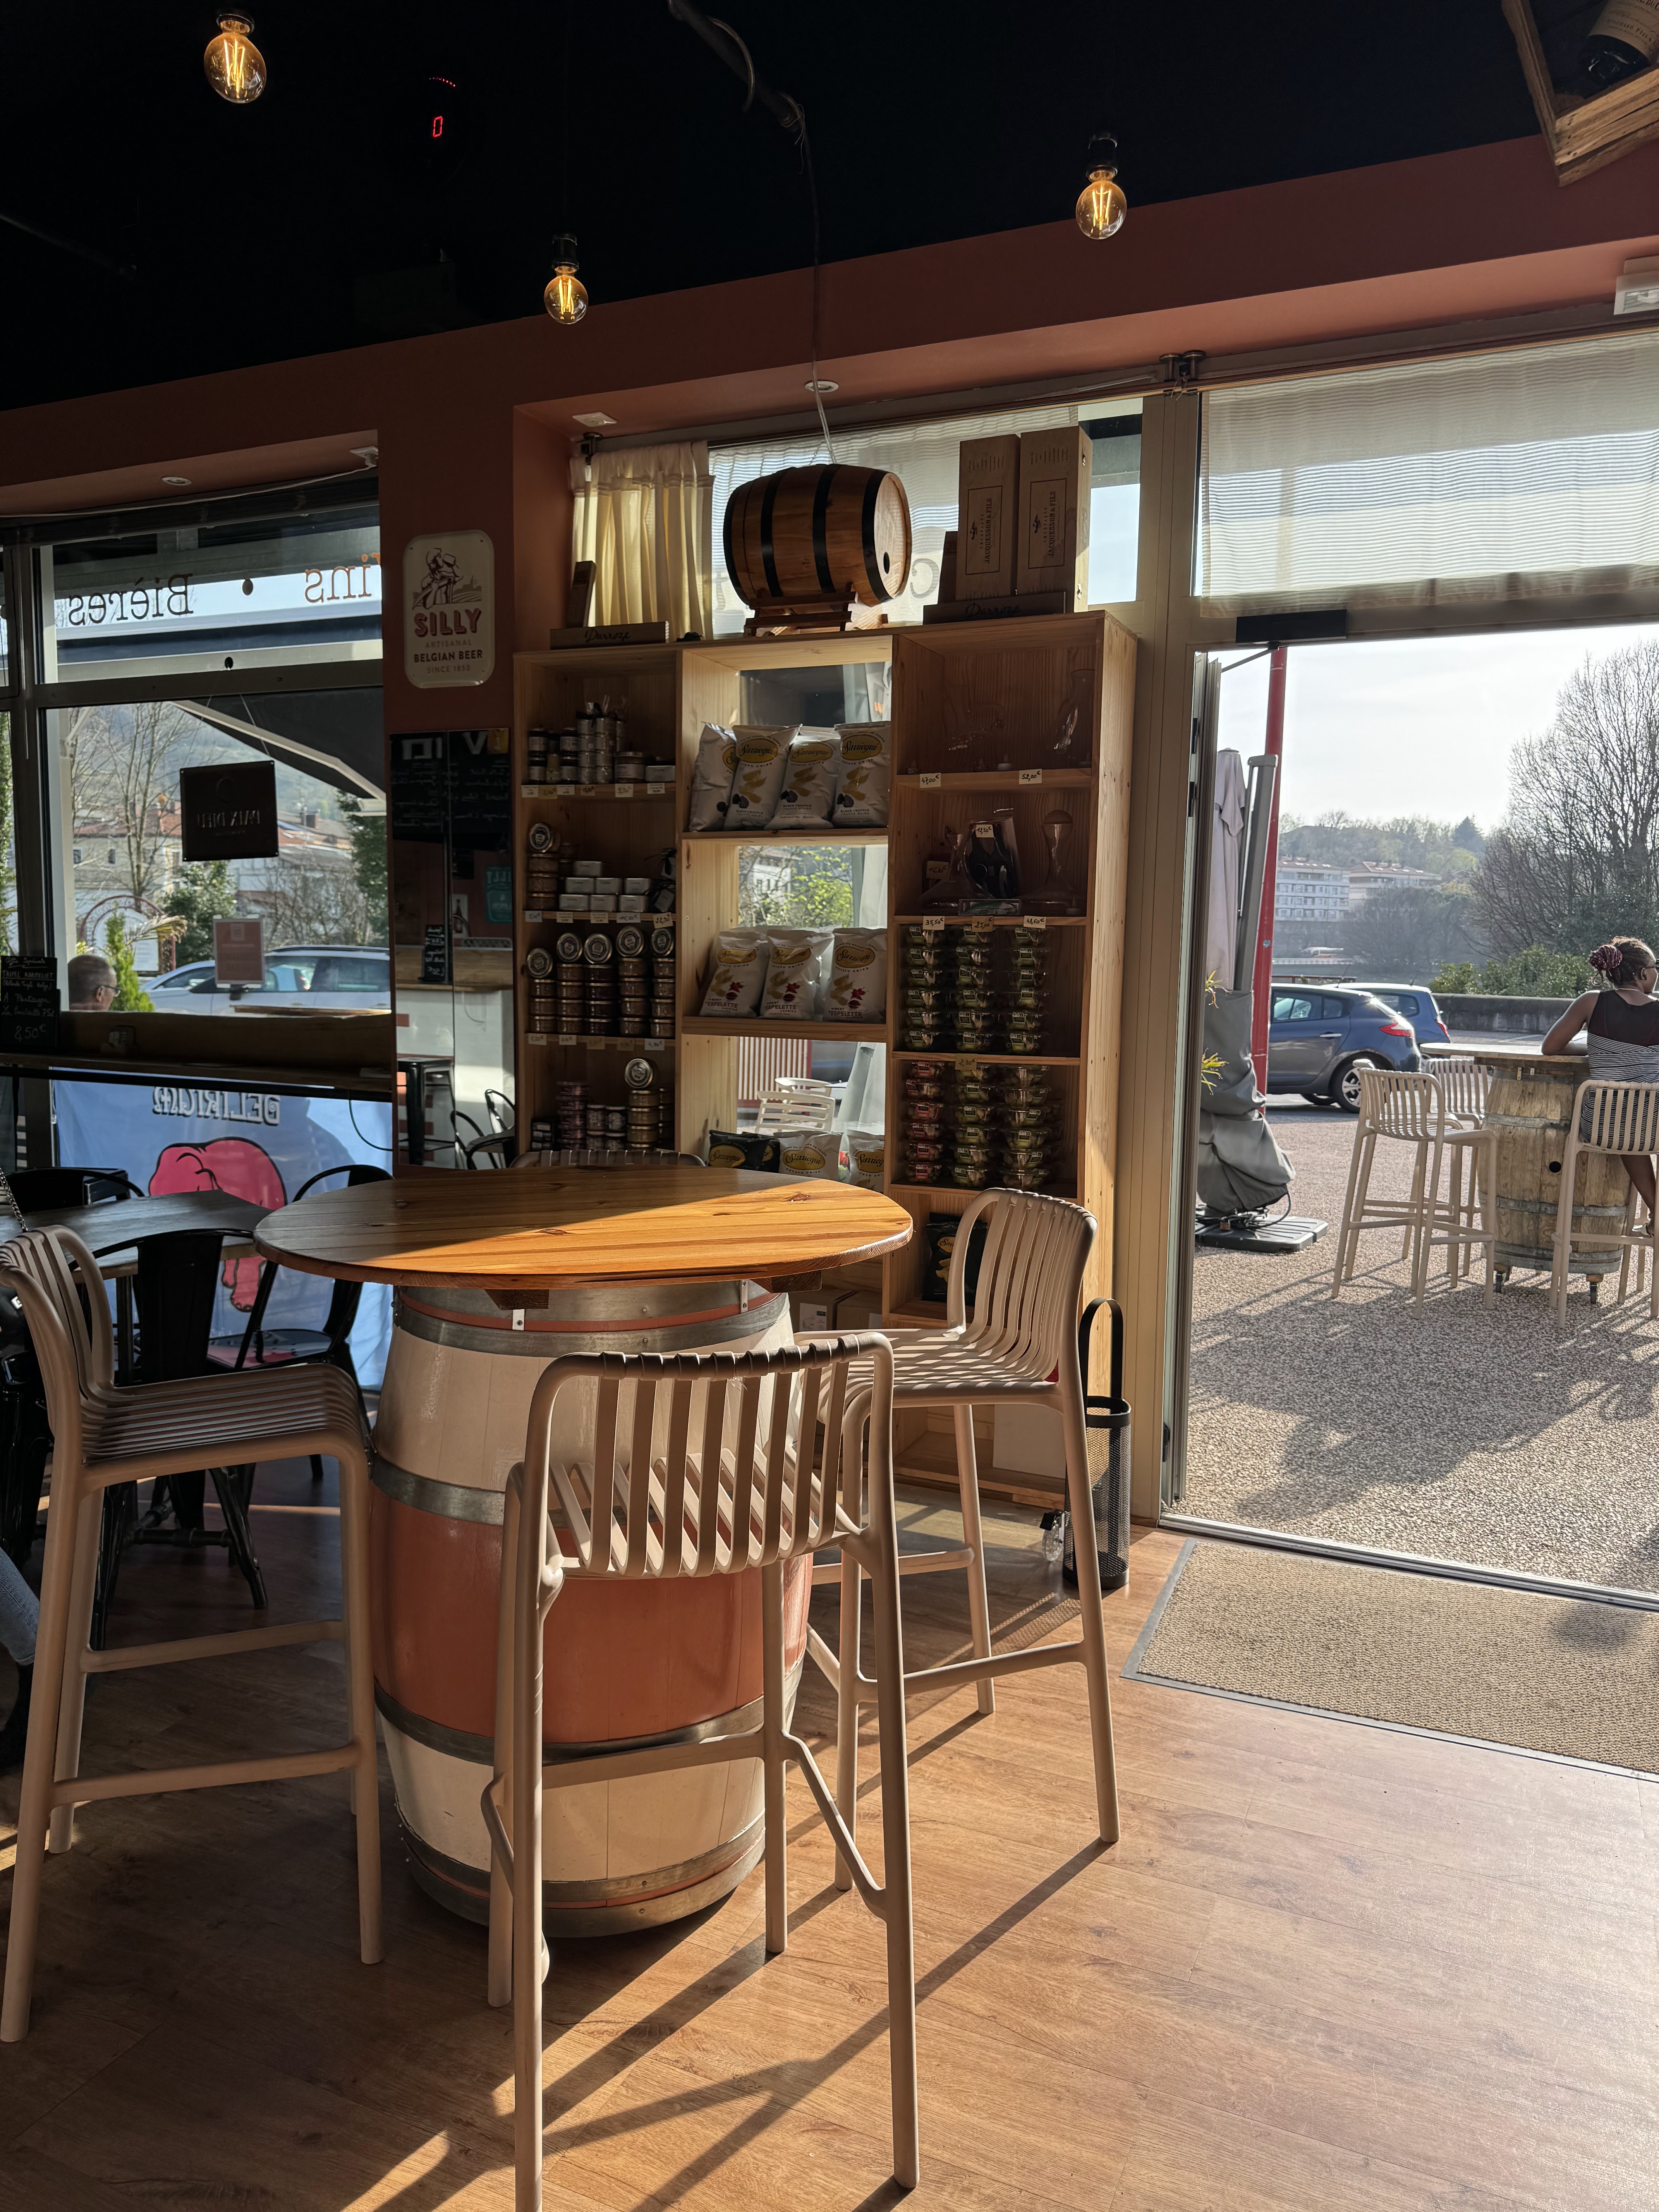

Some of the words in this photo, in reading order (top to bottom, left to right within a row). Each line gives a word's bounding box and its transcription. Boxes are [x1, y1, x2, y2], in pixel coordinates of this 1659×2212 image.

[414, 608, 481, 637] SILLY
[426, 639, 472, 648] ARTISANAL
[414, 652, 455, 662] BELGIAN
[459, 649, 483, 659] BEER
[926, 917, 944, 926] 35,50€
[859, 1154, 883, 1167] Sarrieg
